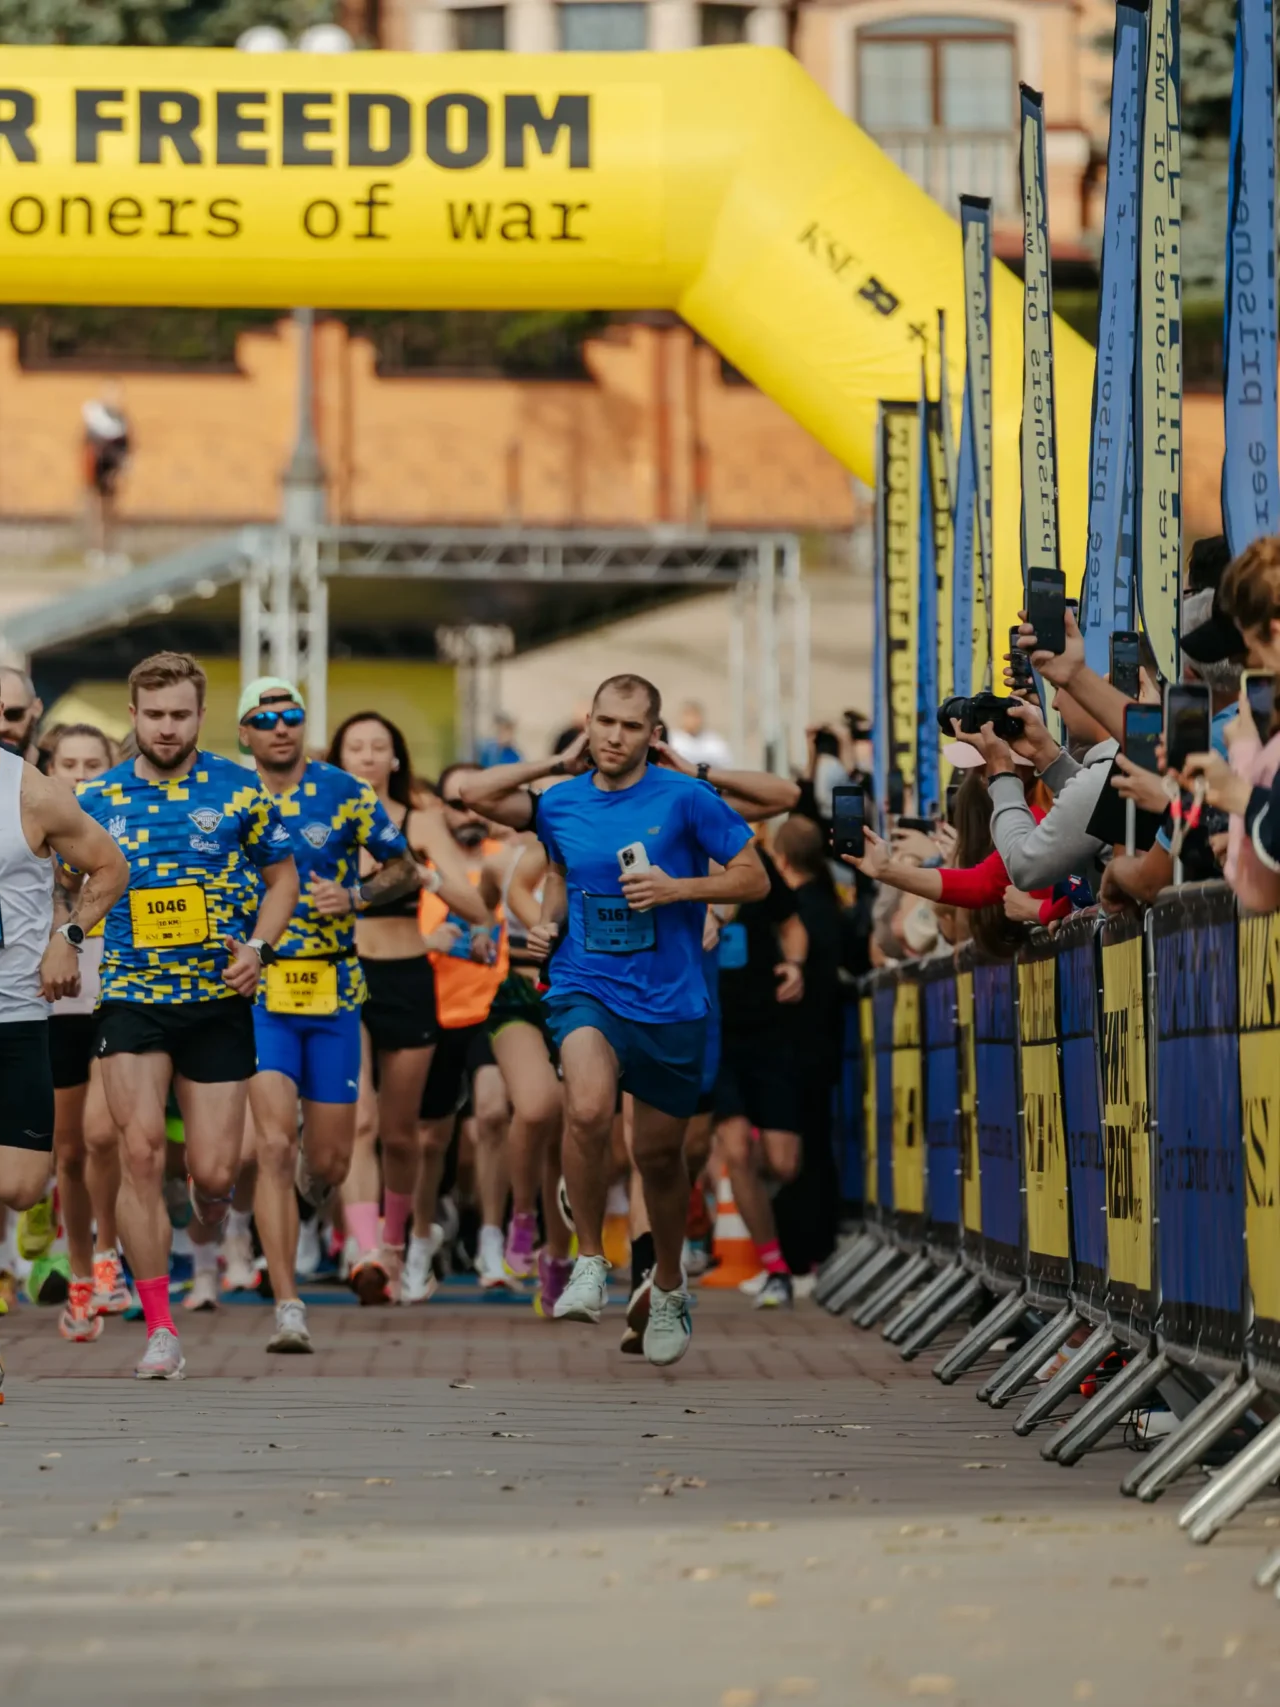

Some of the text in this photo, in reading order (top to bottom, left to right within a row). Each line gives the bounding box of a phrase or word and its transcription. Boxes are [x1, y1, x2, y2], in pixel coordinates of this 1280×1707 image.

[75, 88, 591, 171] FREEDOM
[302, 182, 393, 240] of
[448, 199, 590, 242] war
[147, 898, 187, 915] 1046
[597, 907, 632, 922] 5167
[285, 971, 318, 985] 1145
